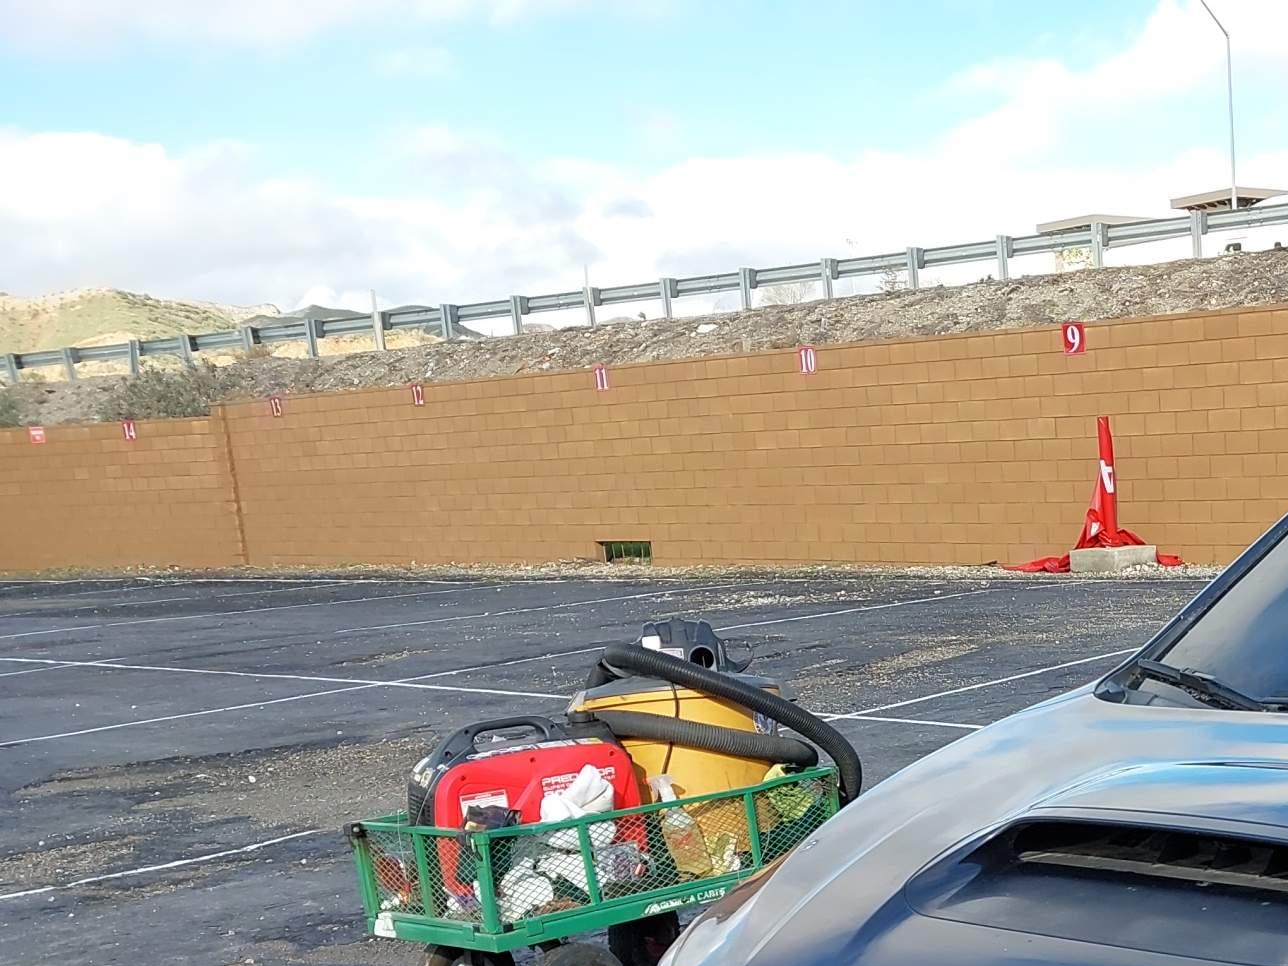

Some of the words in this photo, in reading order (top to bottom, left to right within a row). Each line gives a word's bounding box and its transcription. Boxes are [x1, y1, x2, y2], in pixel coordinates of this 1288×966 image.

[1064, 325, 1081, 353] 9
[800, 348, 815, 372] 10
[595, 368, 608, 390] 11
[412, 386, 424, 405] 12
[123, 424, 136, 440] 14
[541, 767, 615, 785] PREDOR
